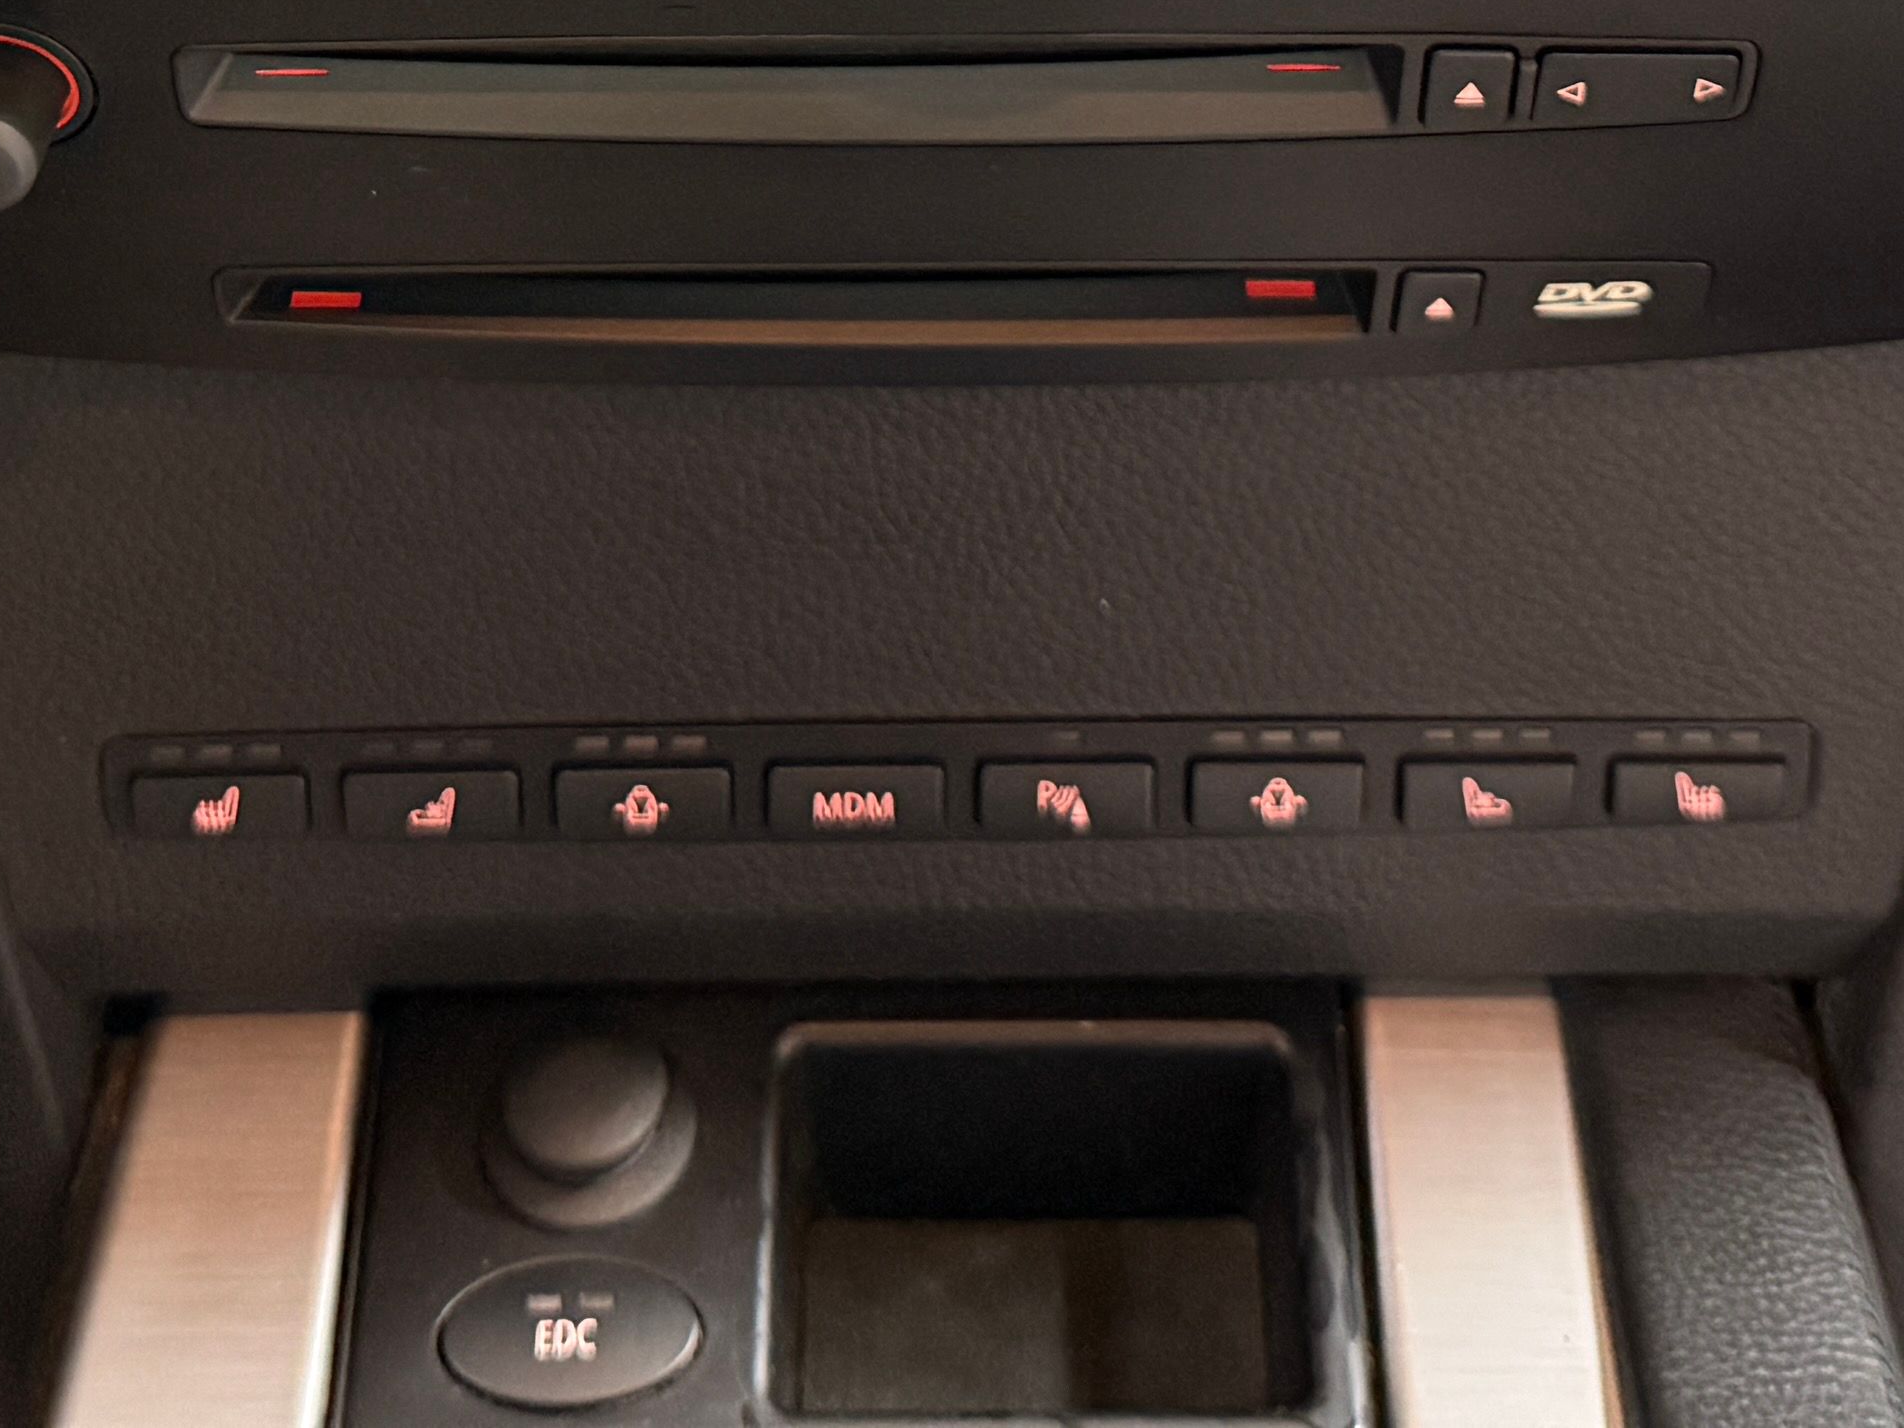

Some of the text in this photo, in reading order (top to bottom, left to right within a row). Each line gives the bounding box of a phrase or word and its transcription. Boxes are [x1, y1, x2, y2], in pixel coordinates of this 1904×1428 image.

[1537, 281, 1653, 305] DVD
[812, 791, 896, 824] MDM
[534, 1318, 597, 1362] EDC
